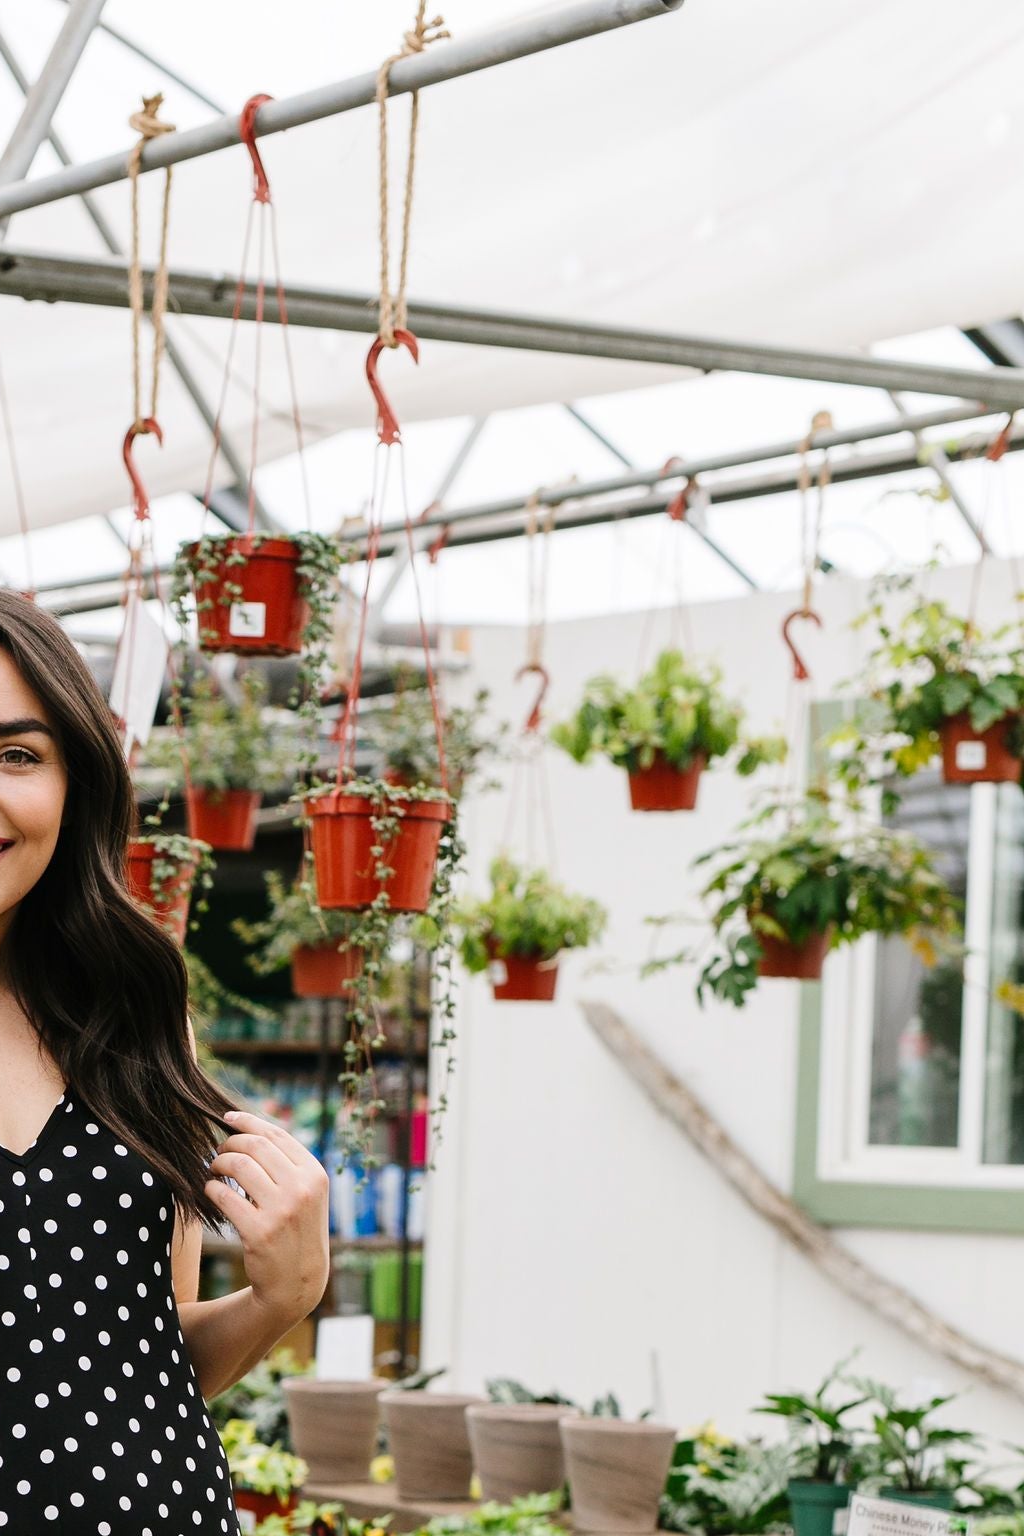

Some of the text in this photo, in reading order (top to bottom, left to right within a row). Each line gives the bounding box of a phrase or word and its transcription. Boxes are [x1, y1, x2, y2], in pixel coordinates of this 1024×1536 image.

[856, 1504, 966, 1536] Chinese Money Plan
